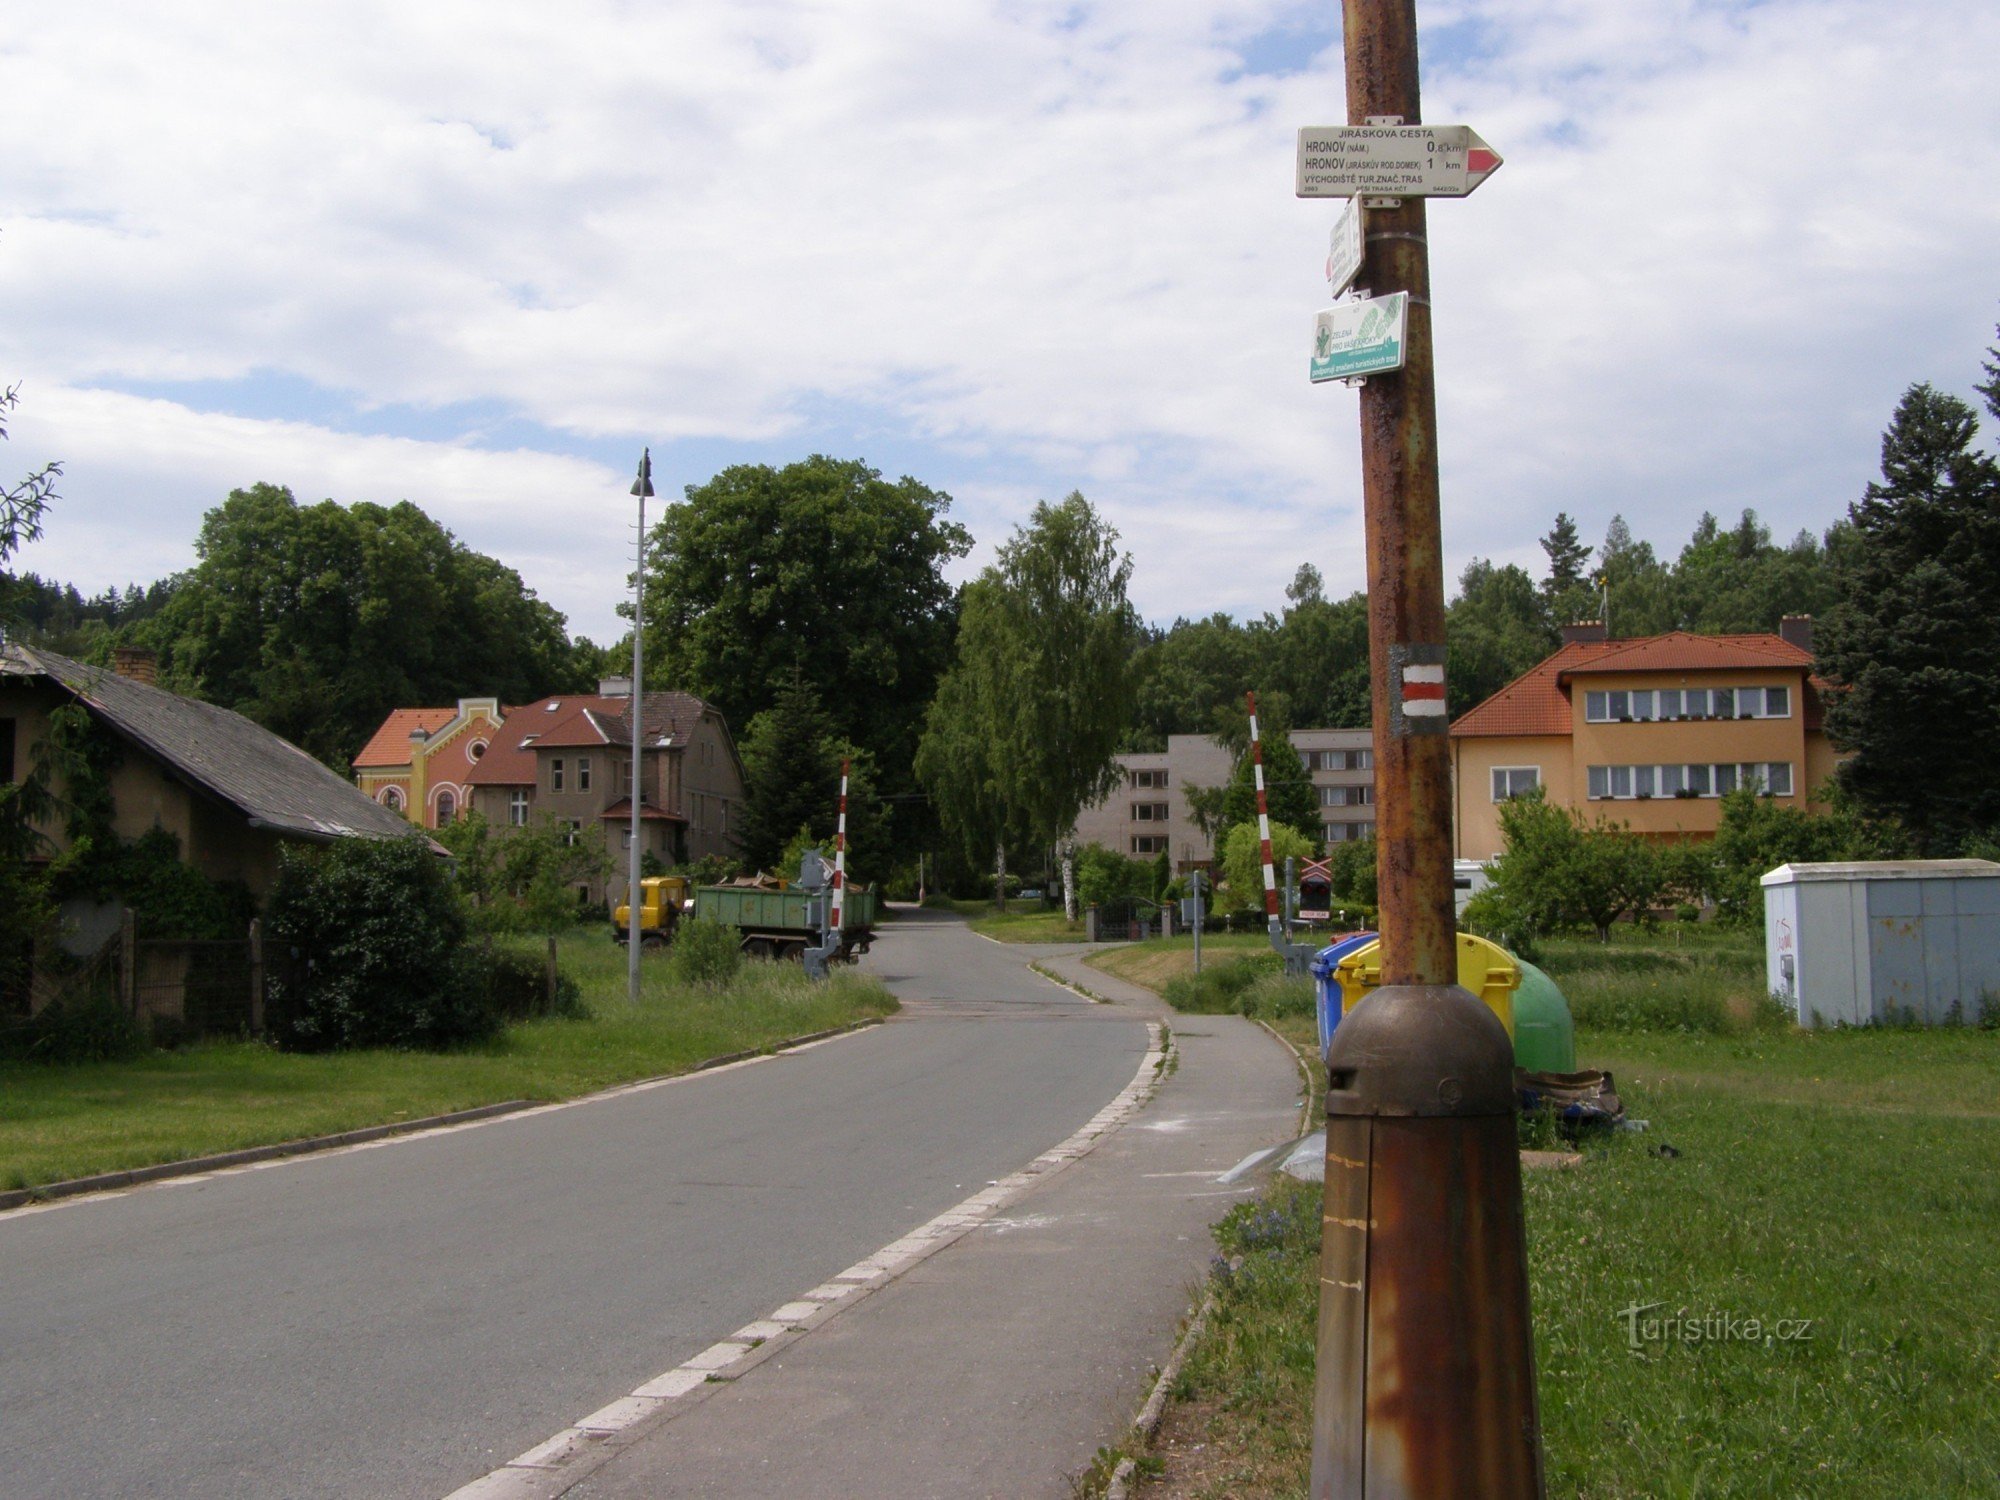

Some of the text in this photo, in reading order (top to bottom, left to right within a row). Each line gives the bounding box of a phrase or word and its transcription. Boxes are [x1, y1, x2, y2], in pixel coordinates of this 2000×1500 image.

[1338, 129, 1435, 138] JIRÁSKOVA CESTA
[1305, 141, 1346, 153] HRONOV
[1446, 144, 1461, 153] km
[1305, 158, 1346, 170] HRONOV
[1427, 158, 1433, 169] 1
